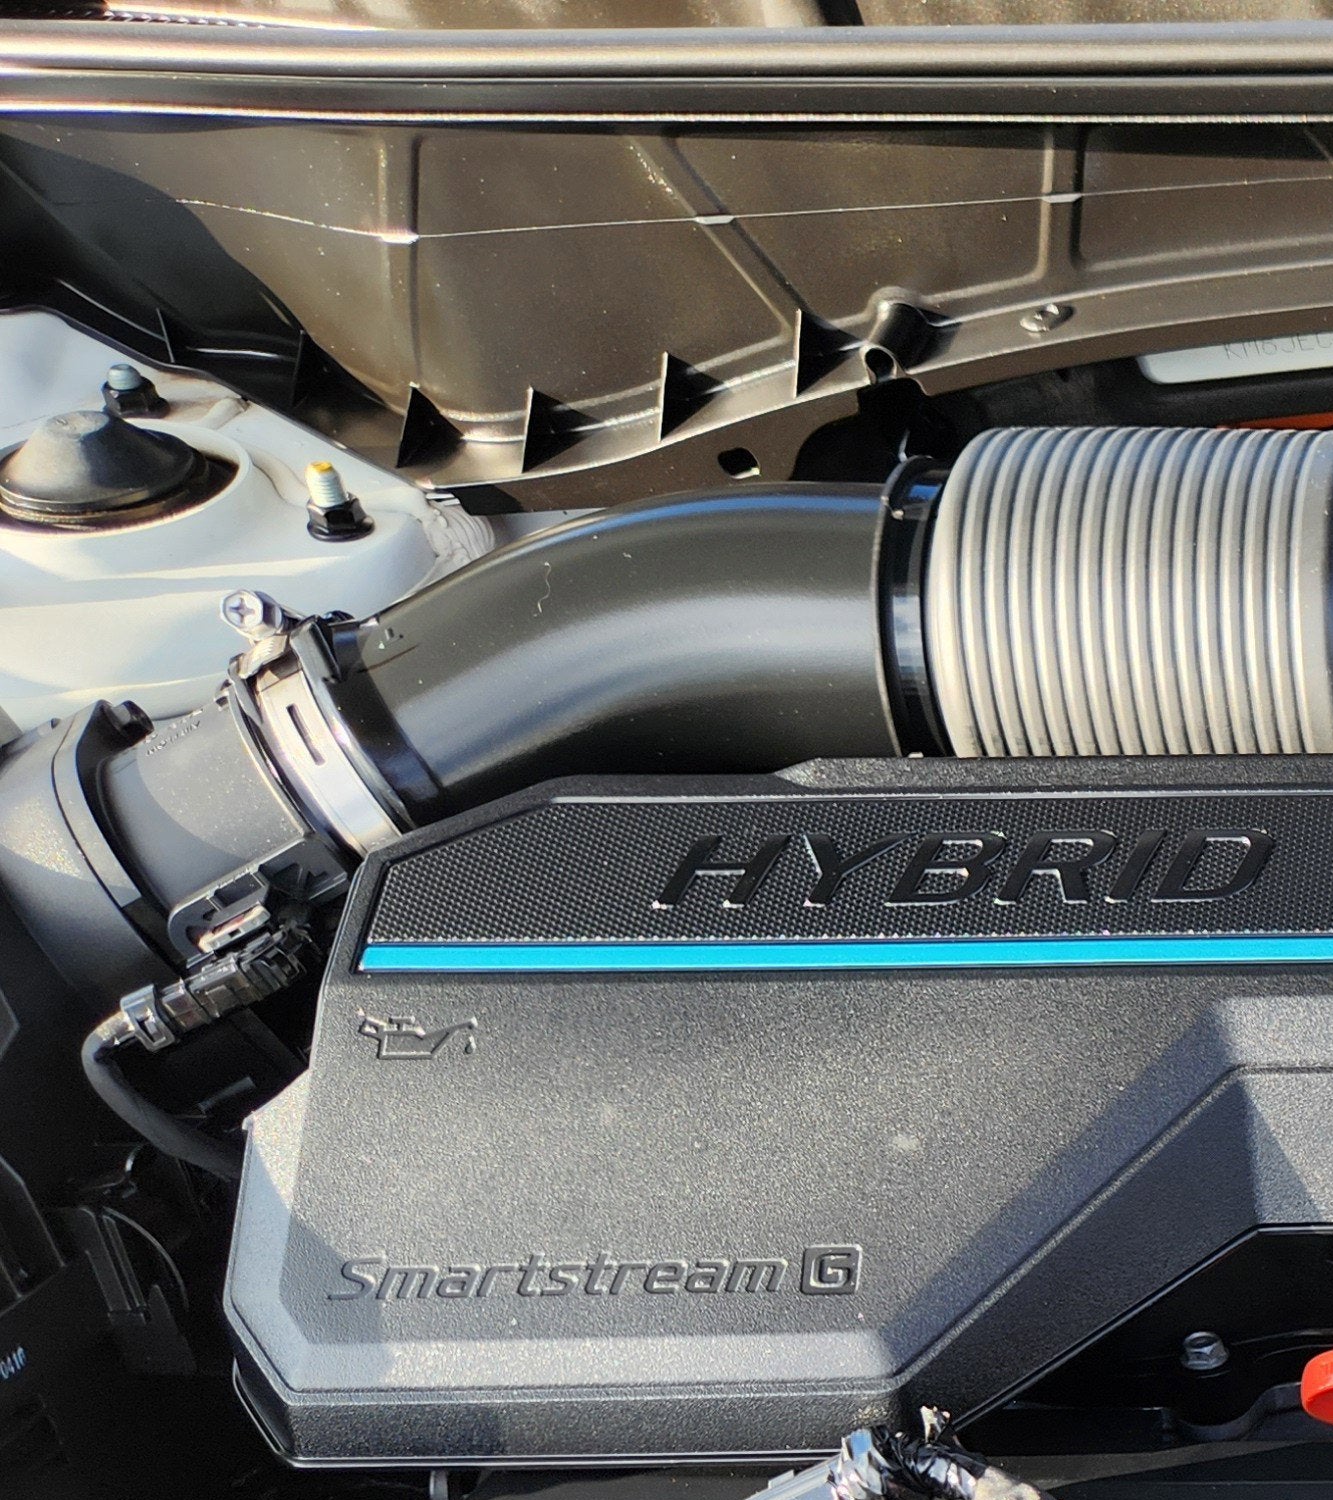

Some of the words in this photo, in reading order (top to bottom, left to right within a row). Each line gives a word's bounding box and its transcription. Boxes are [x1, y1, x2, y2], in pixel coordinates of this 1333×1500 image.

[651, 828, 1276, 910] HYBRID
[327, 1251, 788, 1301] Smartstream
[804, 1246, 860, 1294] G
